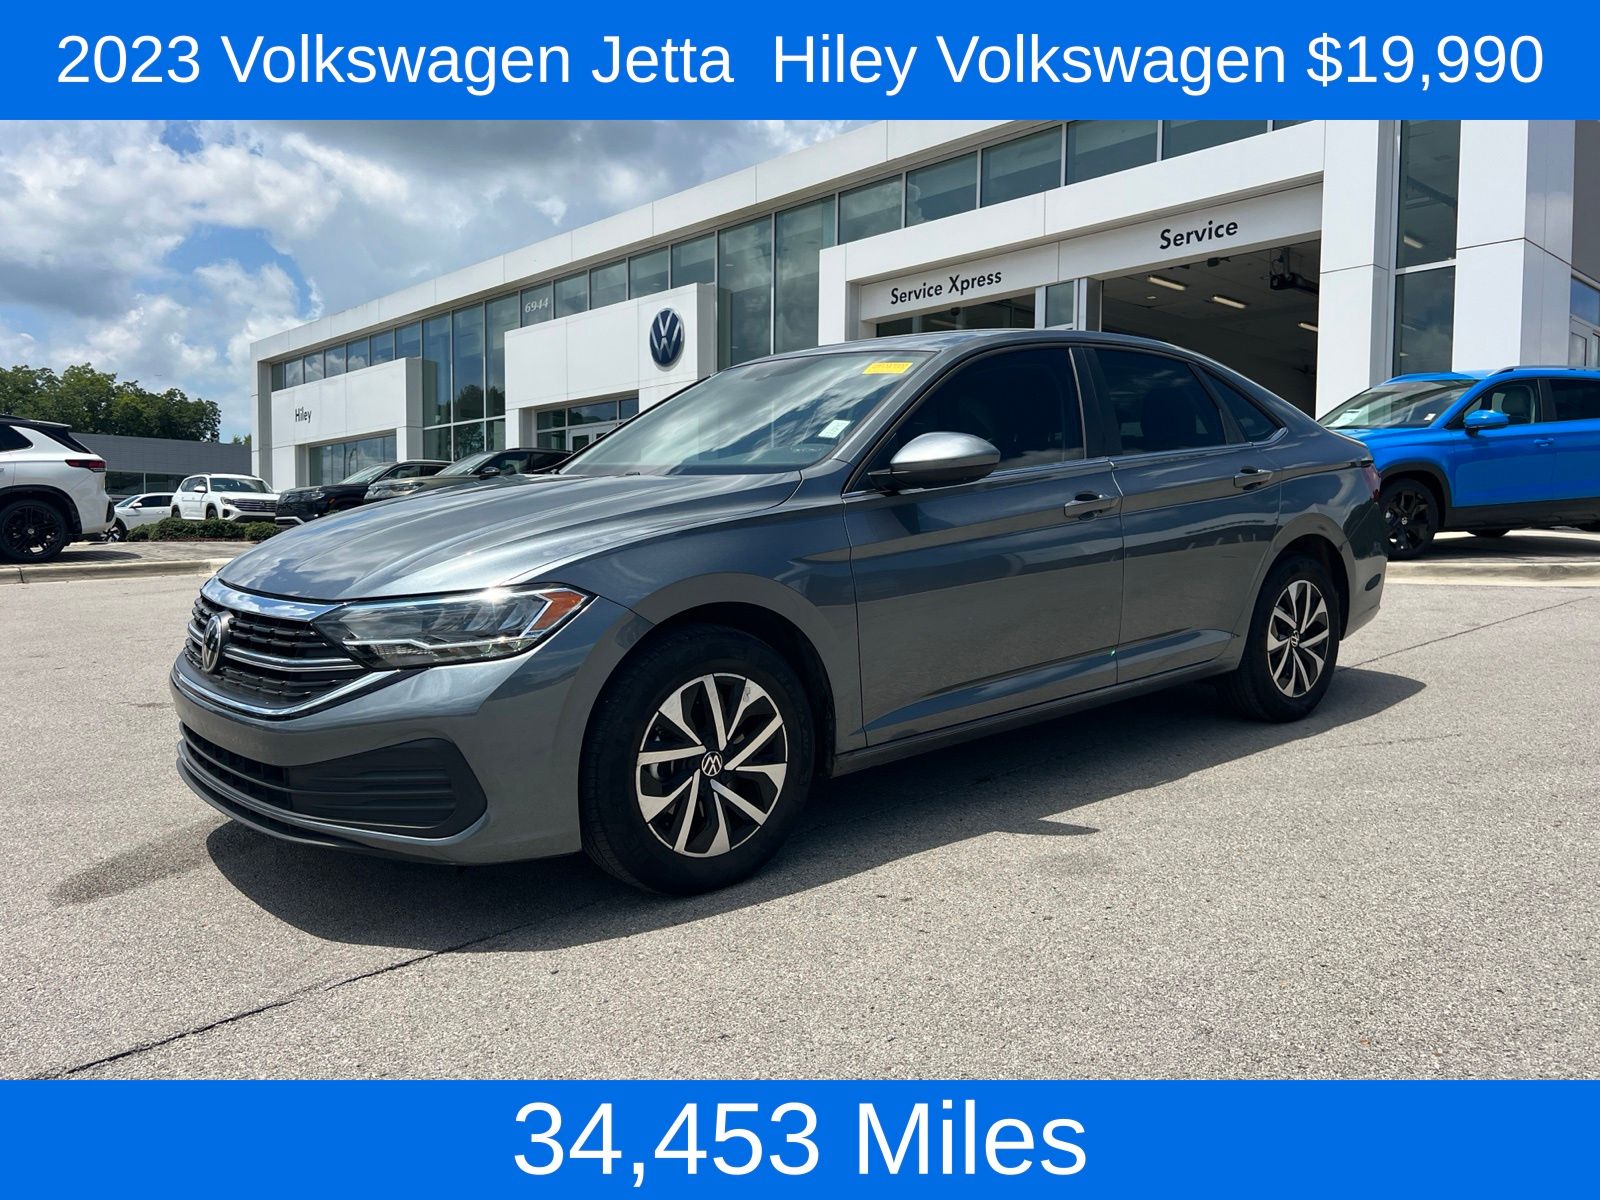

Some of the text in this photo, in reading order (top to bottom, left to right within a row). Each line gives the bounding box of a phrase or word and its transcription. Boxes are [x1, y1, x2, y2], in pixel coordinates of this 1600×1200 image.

[1159, 220, 1239, 250] Service
[890, 270, 1003, 305] Service Xpress
[524, 297, 549, 313] 6944
[294, 406, 312, 423] Hiley
